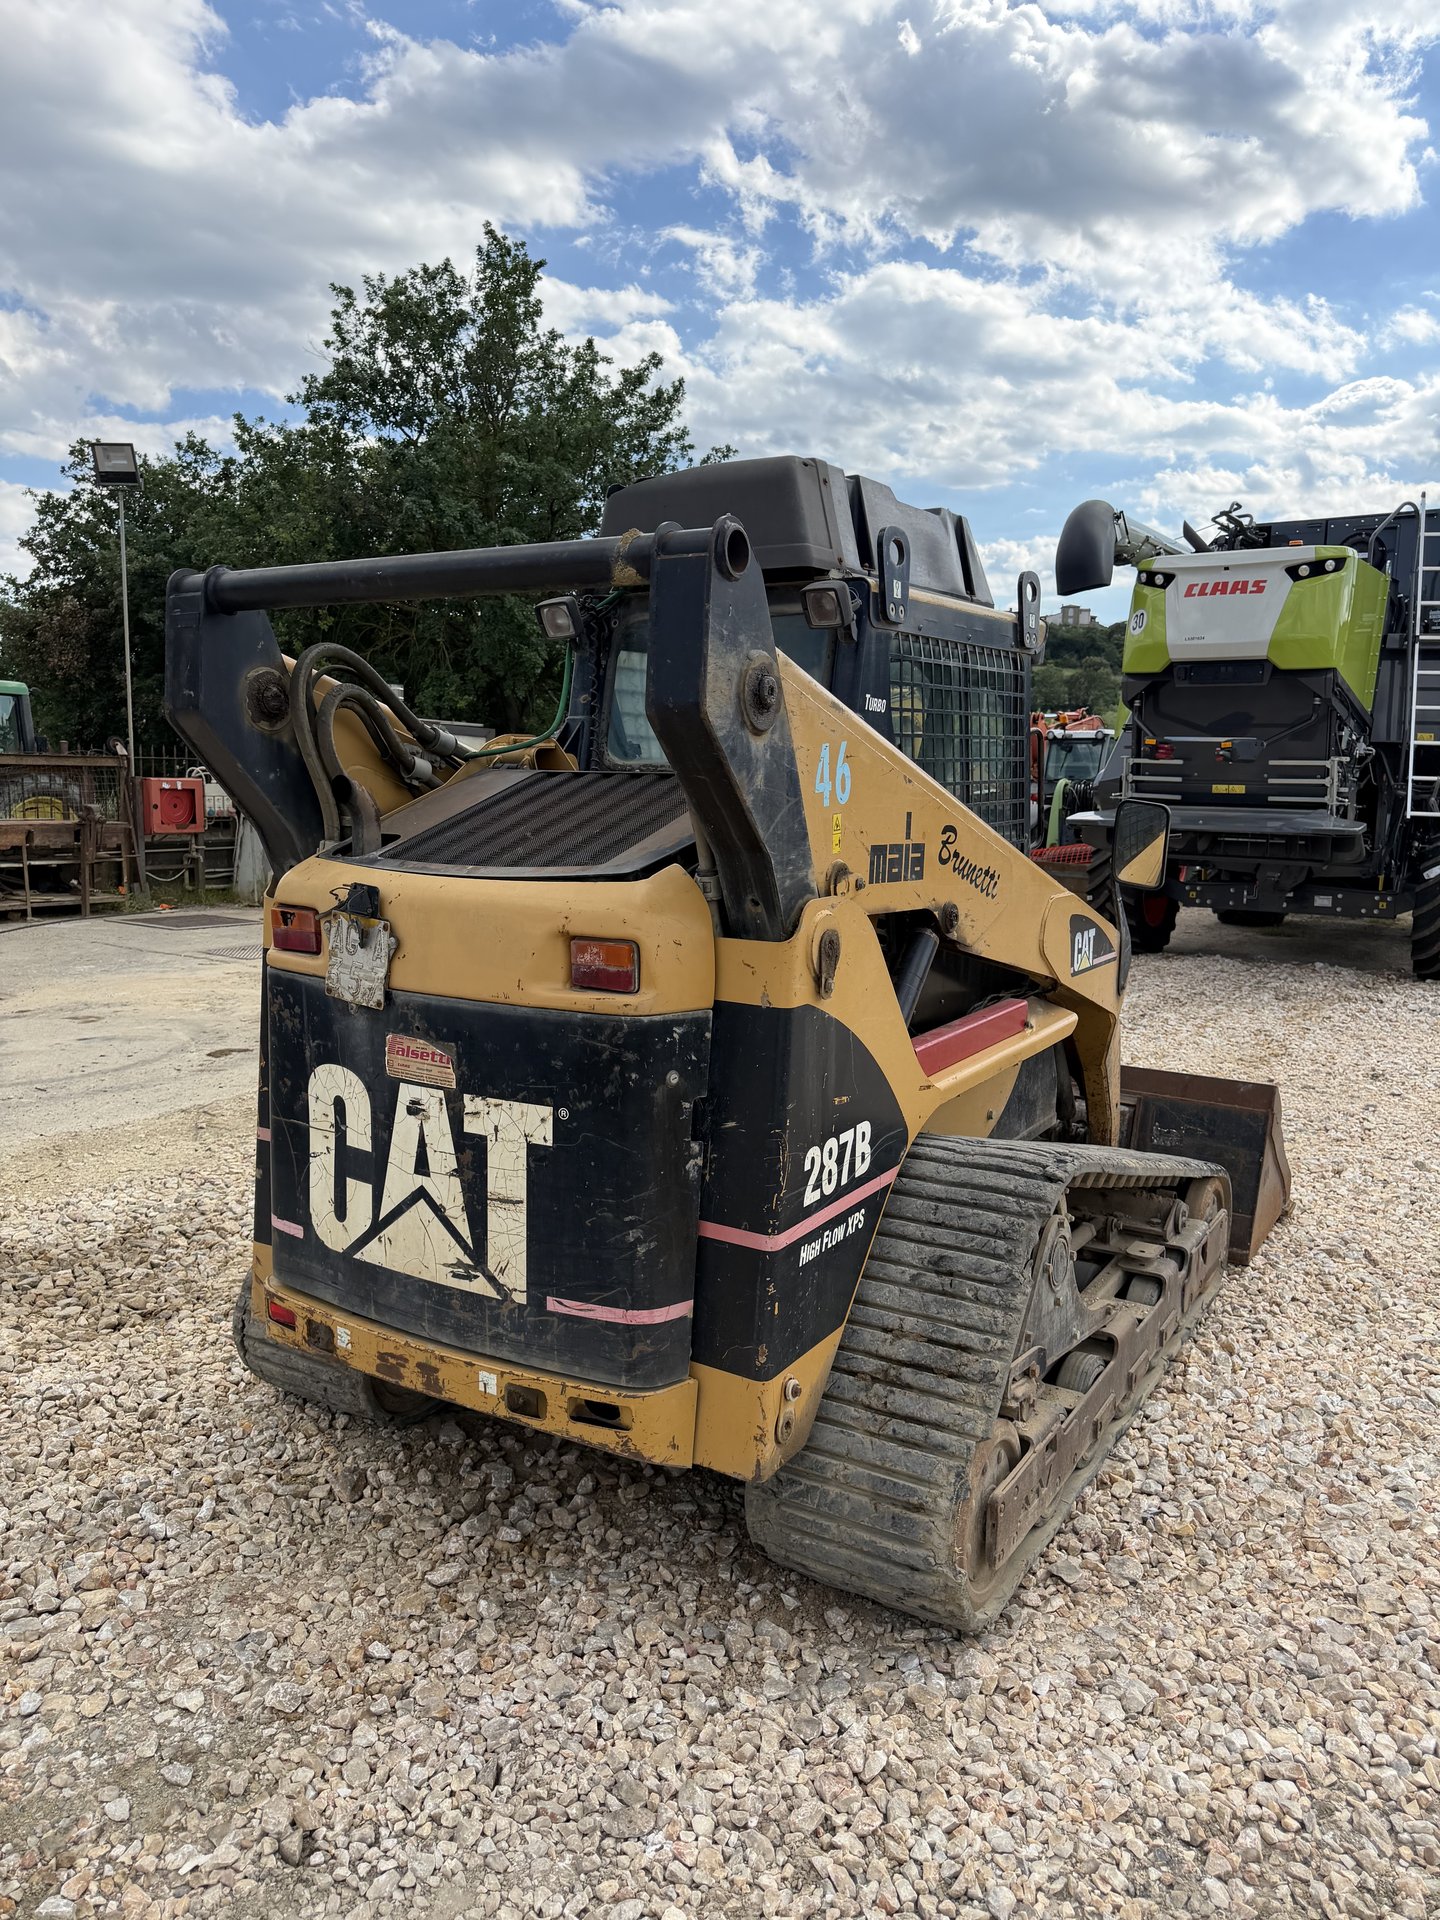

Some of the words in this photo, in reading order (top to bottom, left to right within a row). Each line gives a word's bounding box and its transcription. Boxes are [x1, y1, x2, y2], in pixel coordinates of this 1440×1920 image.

[1184, 579, 1268, 598] CLAAS
[1132, 612, 1145, 631] 30
[815, 740, 852, 807] 46
[938, 824, 1001, 900] Brunetti
[1073, 927, 1096, 972] CAT
[308, 1063, 554, 1304] CAT
[803, 1120, 871, 1208] 287B
[846, 1208, 866, 1236] XPS
